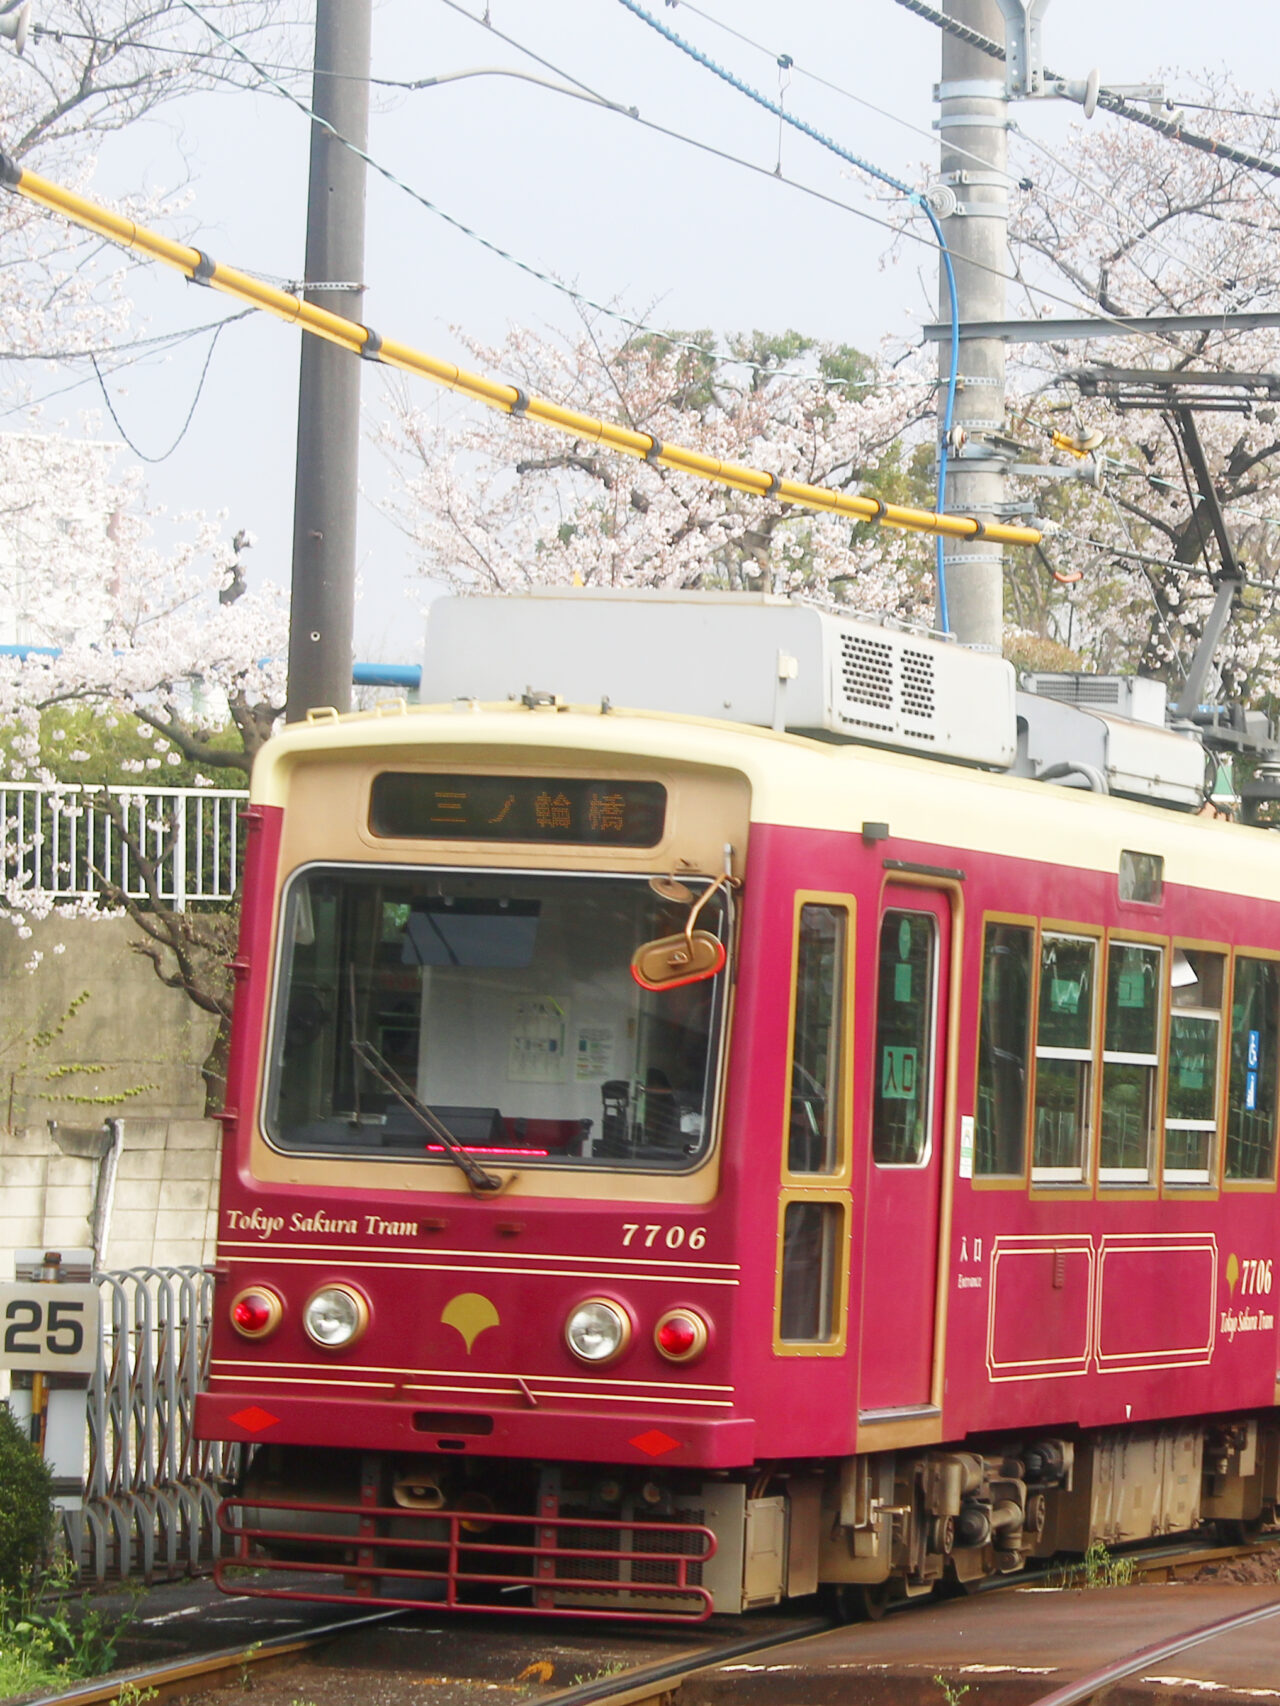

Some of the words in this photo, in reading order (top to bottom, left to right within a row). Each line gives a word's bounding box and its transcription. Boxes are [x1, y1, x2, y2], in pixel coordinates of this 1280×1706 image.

[430, 790, 626, 832] 三ノ輪橋
[883, 1051, 914, 1092] 入口
[226, 1208, 285, 1240] Tokyo
[289, 1210, 358, 1236] Sakura
[364, 1214, 419, 1237] Tram
[621, 1223, 708, 1250] 7706
[959, 1236, 983, 1262] 入口
[1241, 1259, 1273, 1295] 7706
[3, 1299, 85, 1356] 25
[1220, 1307, 1238, 1343] Tokyo
[1237, 1306, 1258, 1332] Sakura
[1258, 1309, 1274, 1331] Tram
